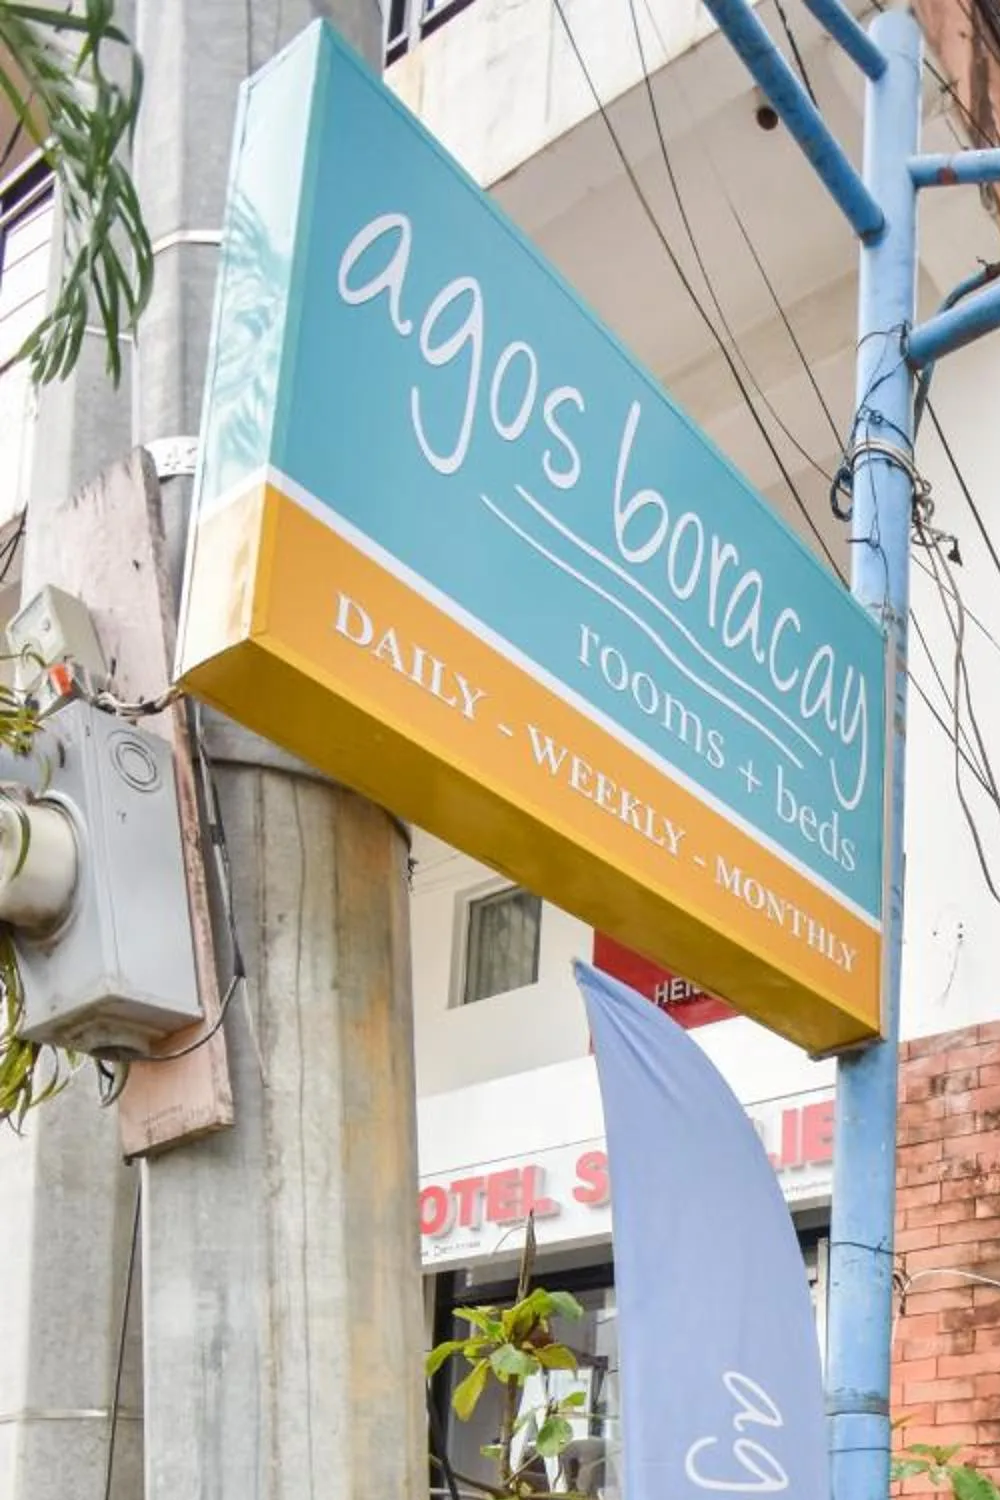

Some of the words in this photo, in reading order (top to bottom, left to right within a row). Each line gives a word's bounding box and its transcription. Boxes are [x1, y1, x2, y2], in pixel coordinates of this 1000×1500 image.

[337, 212, 586, 490] agos
[612, 400, 869, 811] boracay
[334, 593, 488, 720] DAILY
[527, 724, 686, 855] WEEKLY
[716, 855, 857, 972] MONTHLY
[576, 622, 725, 770] rooms
[774, 766, 858, 873] beds
